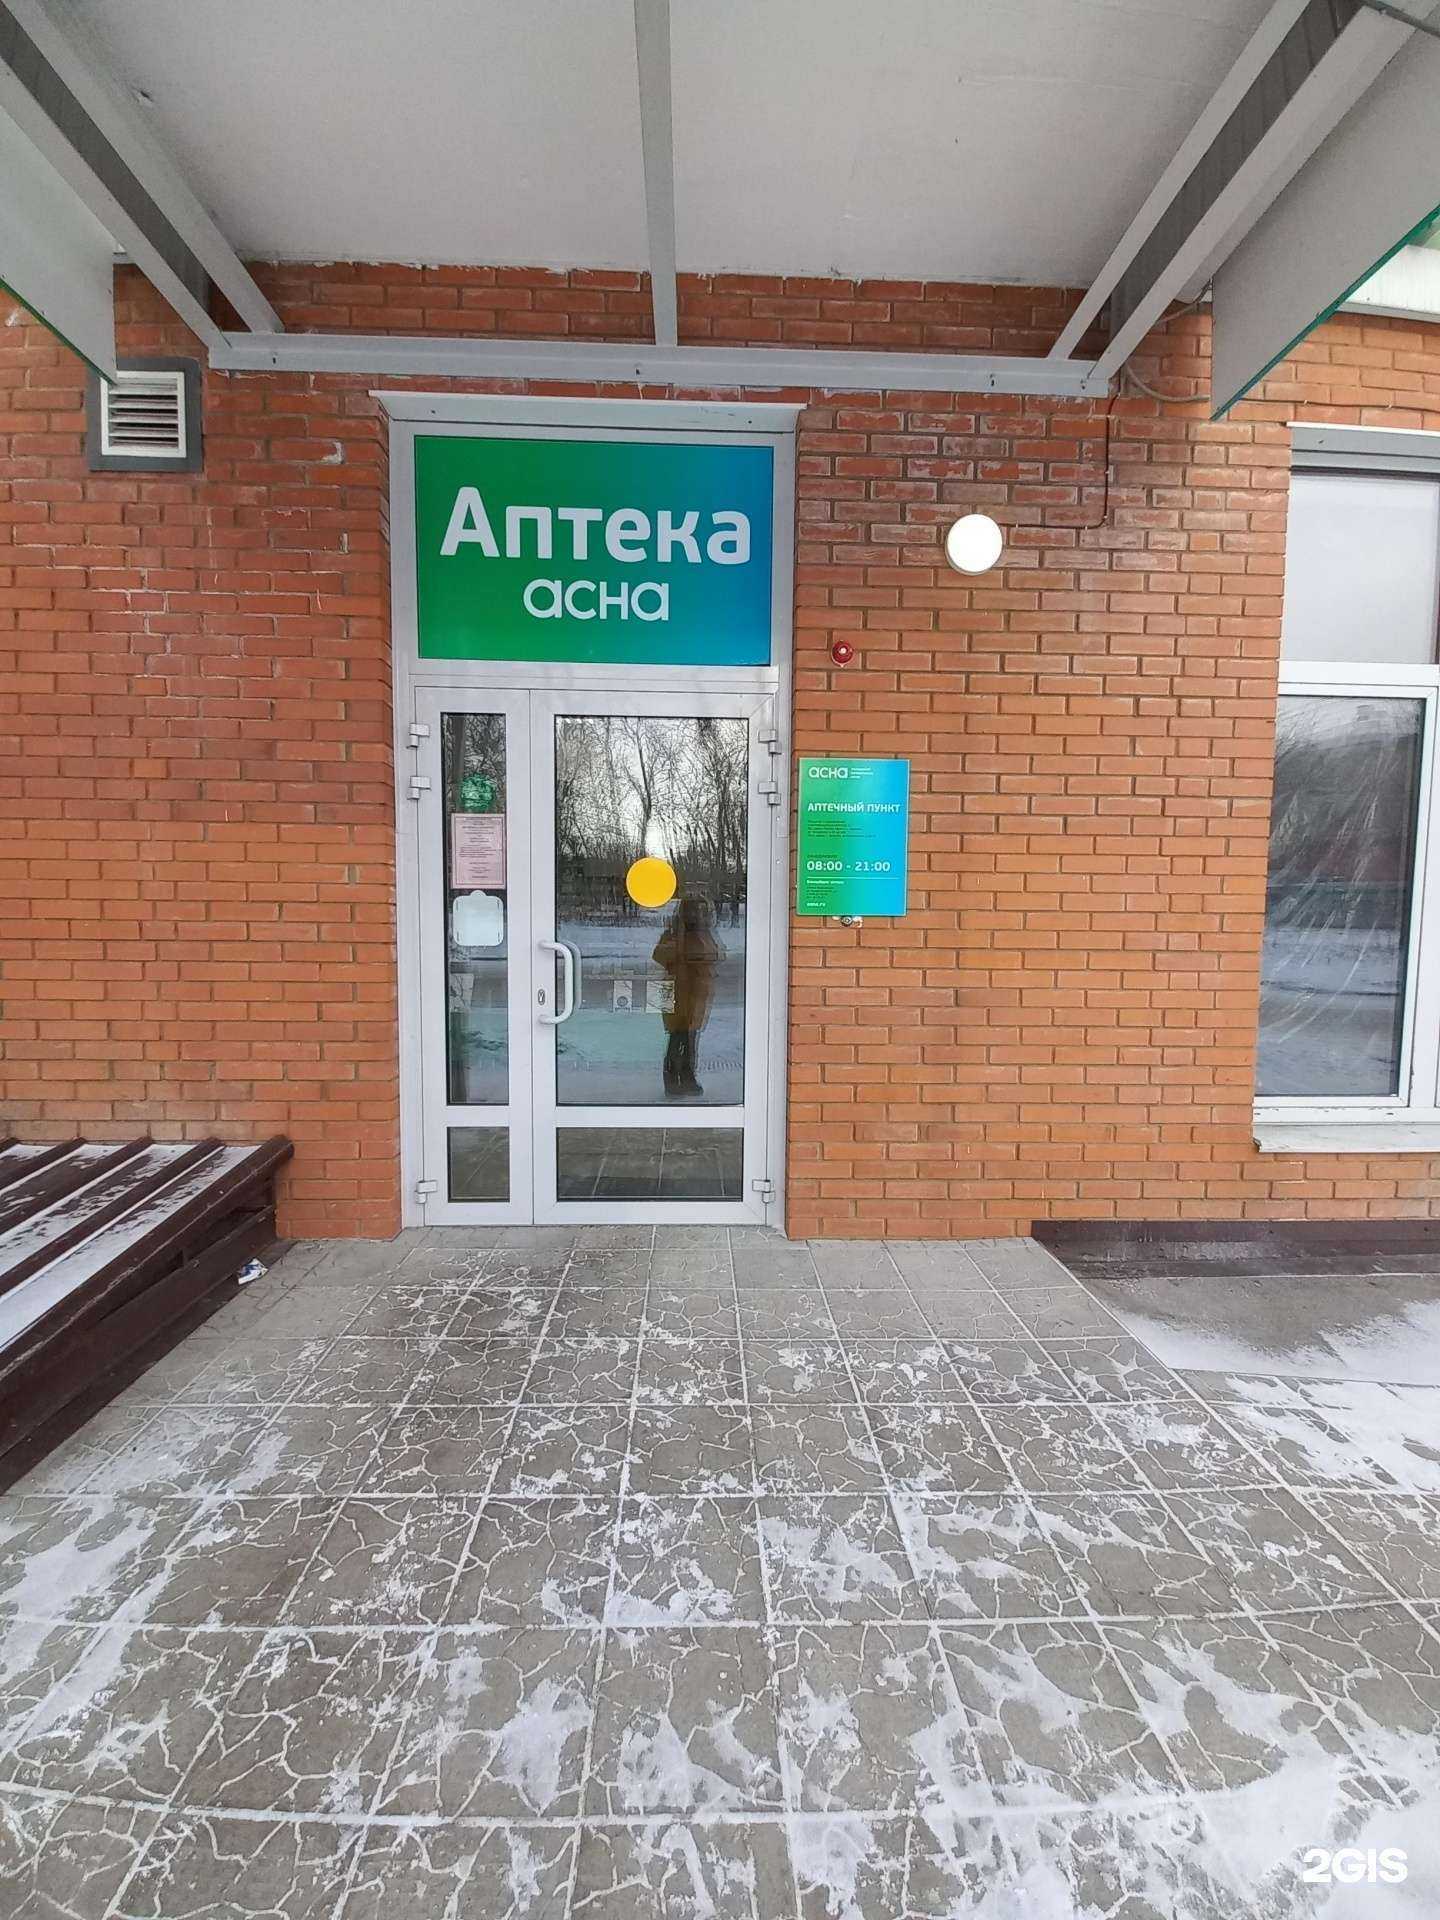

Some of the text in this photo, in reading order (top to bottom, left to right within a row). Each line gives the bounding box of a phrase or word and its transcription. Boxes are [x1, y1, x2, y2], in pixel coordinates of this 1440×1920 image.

[440, 486, 750, 565] Аптека
[523, 578, 669, 621] асна
[808, 766, 848, 779] асна
[808, 801, 900, 813] АПТЕЧНЫЙ ПУНКТ
[807, 860, 843, 871] 08:00
[855, 861, 891, 872] 21:00
